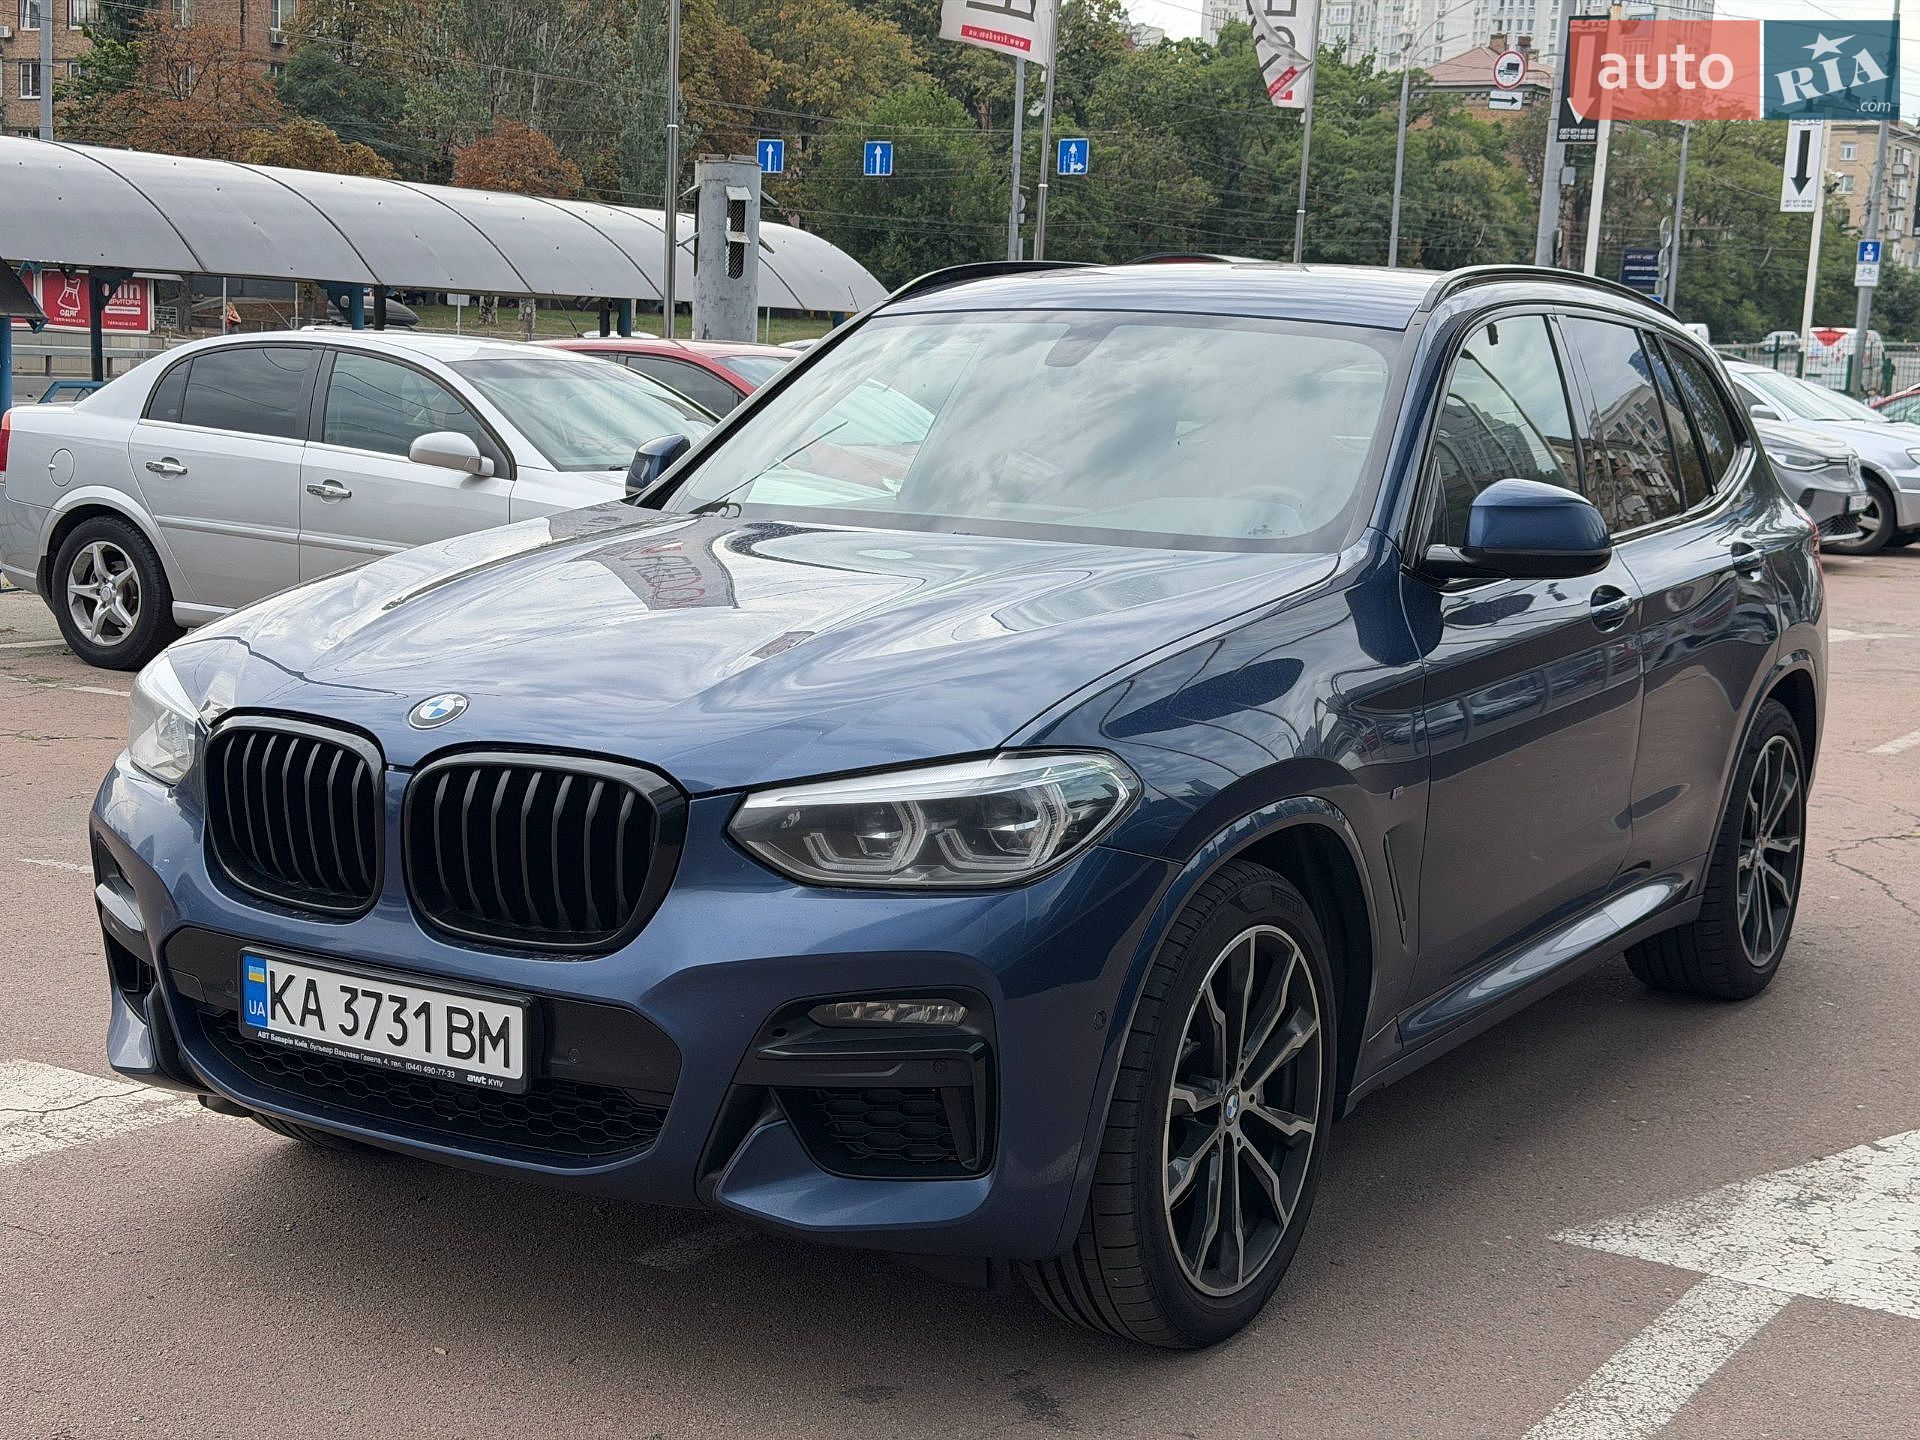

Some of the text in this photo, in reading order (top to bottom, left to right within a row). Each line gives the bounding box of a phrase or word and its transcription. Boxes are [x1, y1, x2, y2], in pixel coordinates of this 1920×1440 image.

[59, 309, 78, 318] ОДЯГ
[248, 1000, 266, 1018] UA
[338, 984, 432, 1054] 3731
[447, 1005, 511, 1069] BM
[257, 1030, 270, 1040] АВТ
[405, 1062, 422, 1073] (044)
[423, 1066, 456, 1079] 490-77-33
[488, 1077, 504, 1089] KYIV
